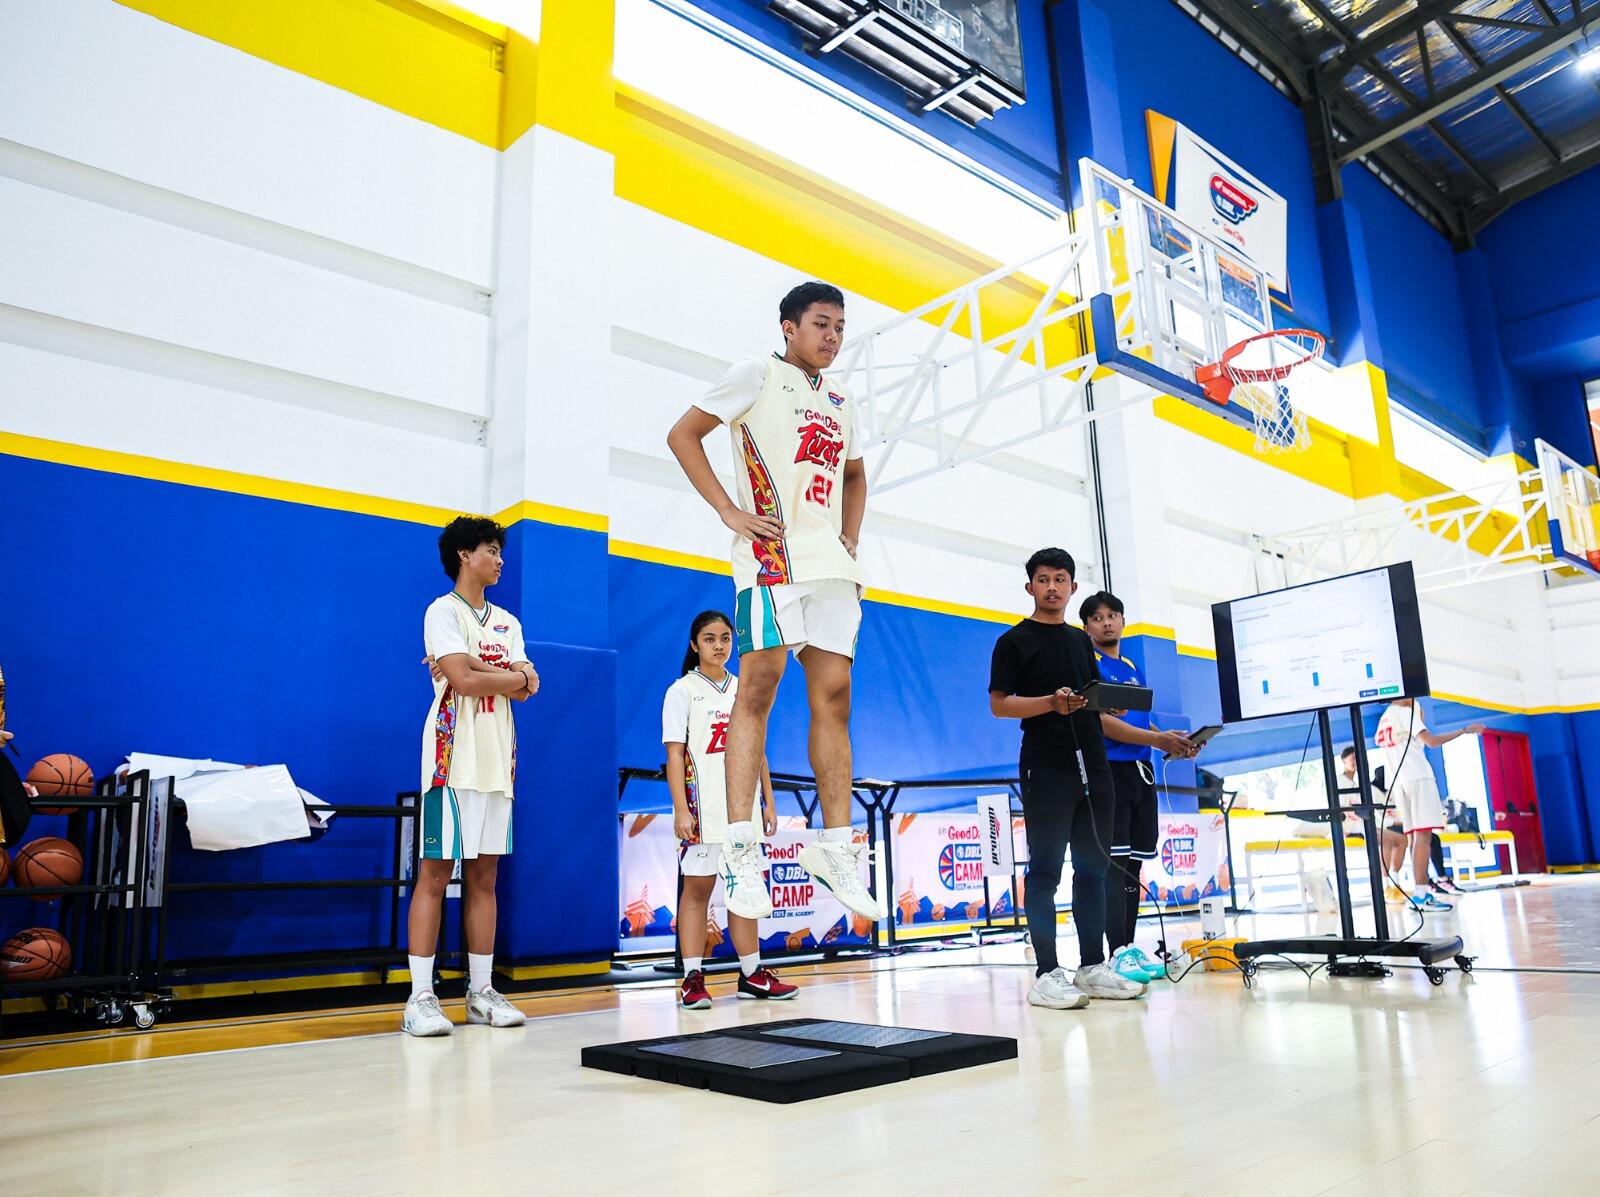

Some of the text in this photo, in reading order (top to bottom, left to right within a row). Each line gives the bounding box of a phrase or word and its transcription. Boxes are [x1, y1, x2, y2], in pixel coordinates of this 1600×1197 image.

[794, 422, 844, 467] First
[948, 825, 975, 840] Good
[988, 806, 1000, 866] proteam
[1168, 824, 1199, 838] Good Day
[765, 842, 794, 859] Good
[1174, 854, 1197, 868] CAMP
[785, 866, 809, 880] DBL
[772, 885, 814, 908] CAMP
